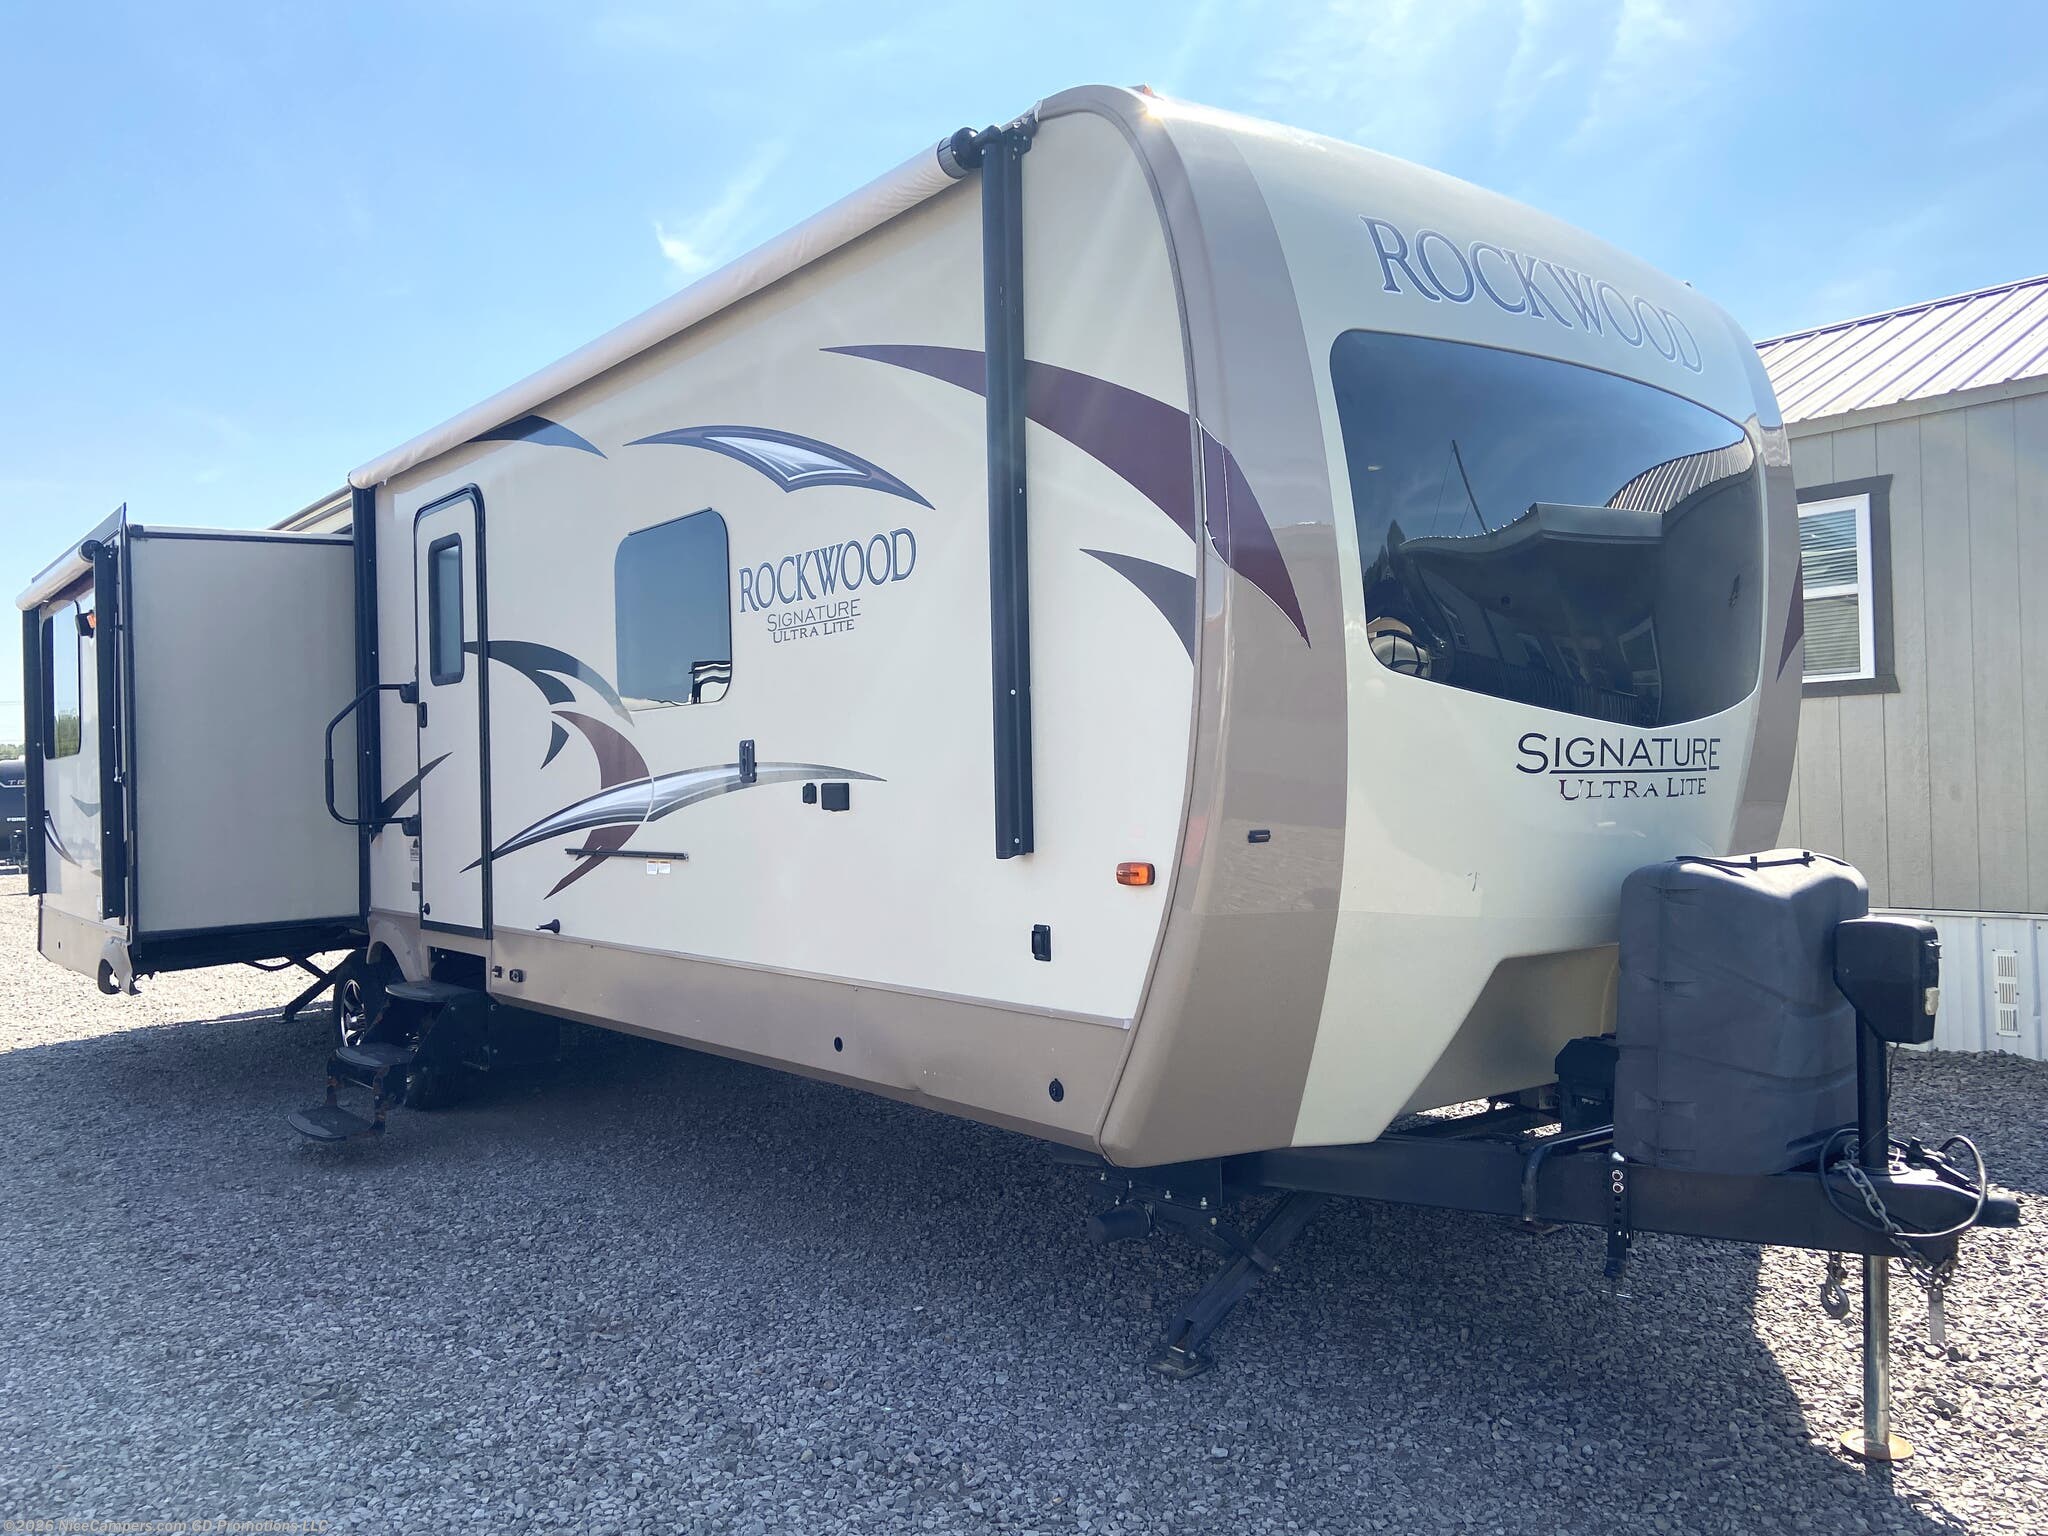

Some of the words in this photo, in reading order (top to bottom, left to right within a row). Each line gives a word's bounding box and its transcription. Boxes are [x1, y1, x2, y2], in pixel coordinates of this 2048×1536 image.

[1359, 214, 1703, 373] ROCKWOOD
[738, 527, 916, 613] ROCKWOOD
[767, 599, 861, 631] SIGNATURE
[772, 625, 818, 643] ULTRA
[824, 619, 855, 635] LITE
[1516, 732, 1720, 774] SIGNATURE
[1559, 779, 1658, 800] ULTRA
[1666, 777, 1706, 797] LITE
